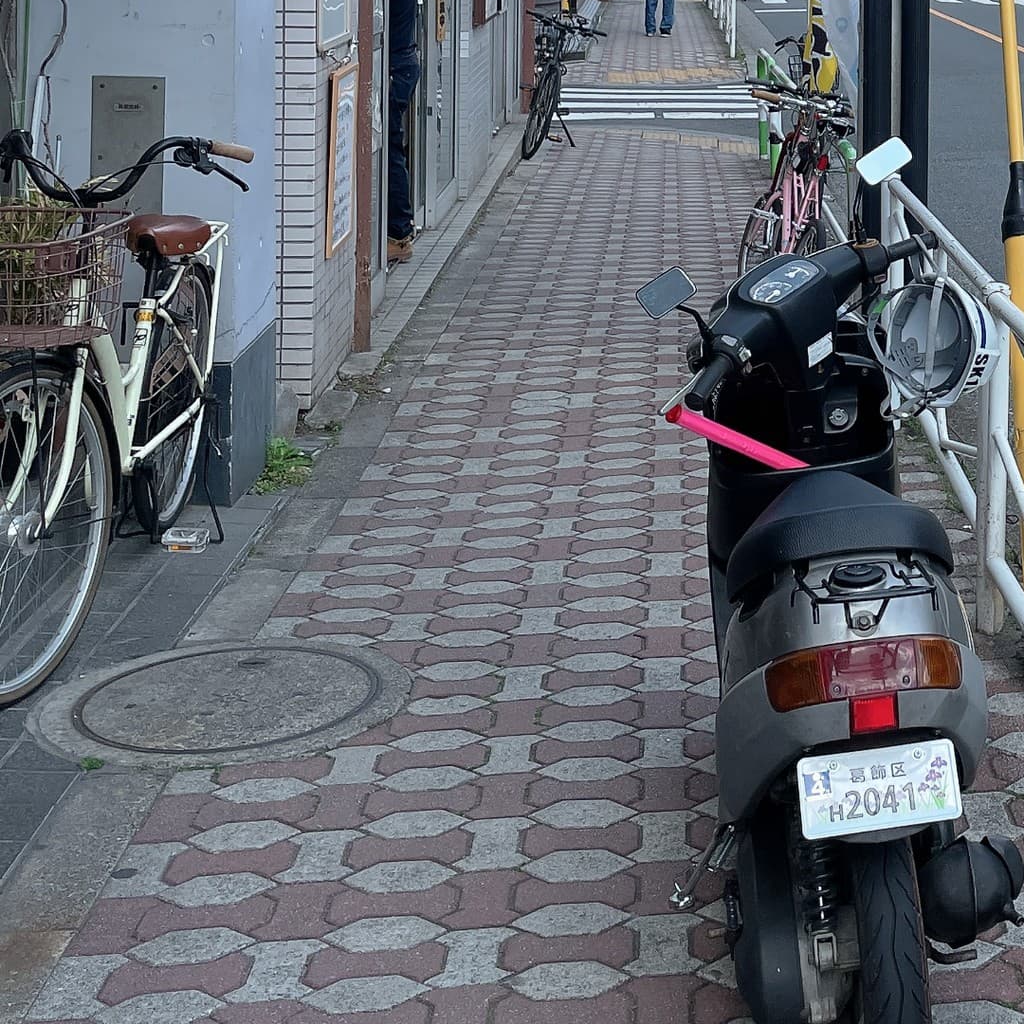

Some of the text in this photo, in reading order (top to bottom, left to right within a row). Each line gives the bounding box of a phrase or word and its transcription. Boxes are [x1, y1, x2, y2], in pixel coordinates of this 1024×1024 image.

[849, 762, 907, 783] 葛飾区
[829, 804, 844, 822] H
[845, 782, 916, 820] 2041
